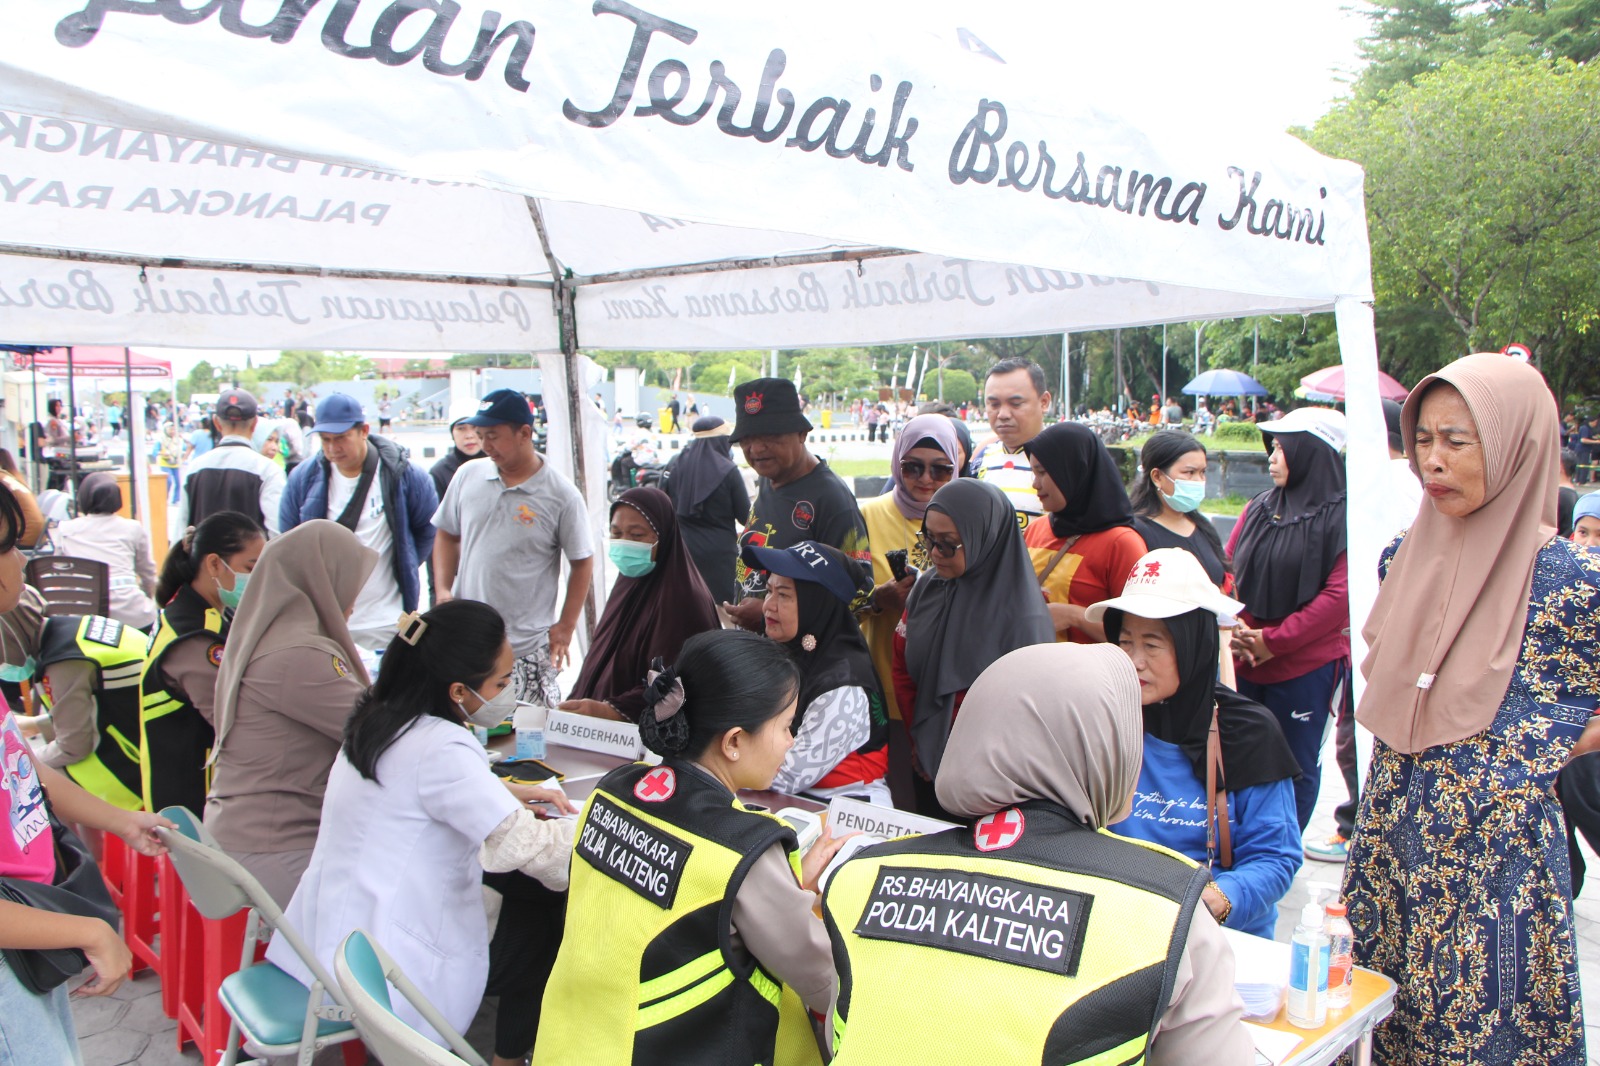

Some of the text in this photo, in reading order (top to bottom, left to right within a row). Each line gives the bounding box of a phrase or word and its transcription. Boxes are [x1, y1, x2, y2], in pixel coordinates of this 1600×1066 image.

[562, 0, 919, 172] Terbaik
[948, 97, 1208, 226] Bersama
[1217, 165, 1327, 246] Kami
[549, 720, 635, 748] LAB SEDERHANA
[836, 811, 923, 838] PENDAFTA
[606, 843, 669, 897] KALTENG
[878, 875, 1070, 925] RS.BHAYANGKARA
[864, 901, 1064, 959] POLDA KALTENG
